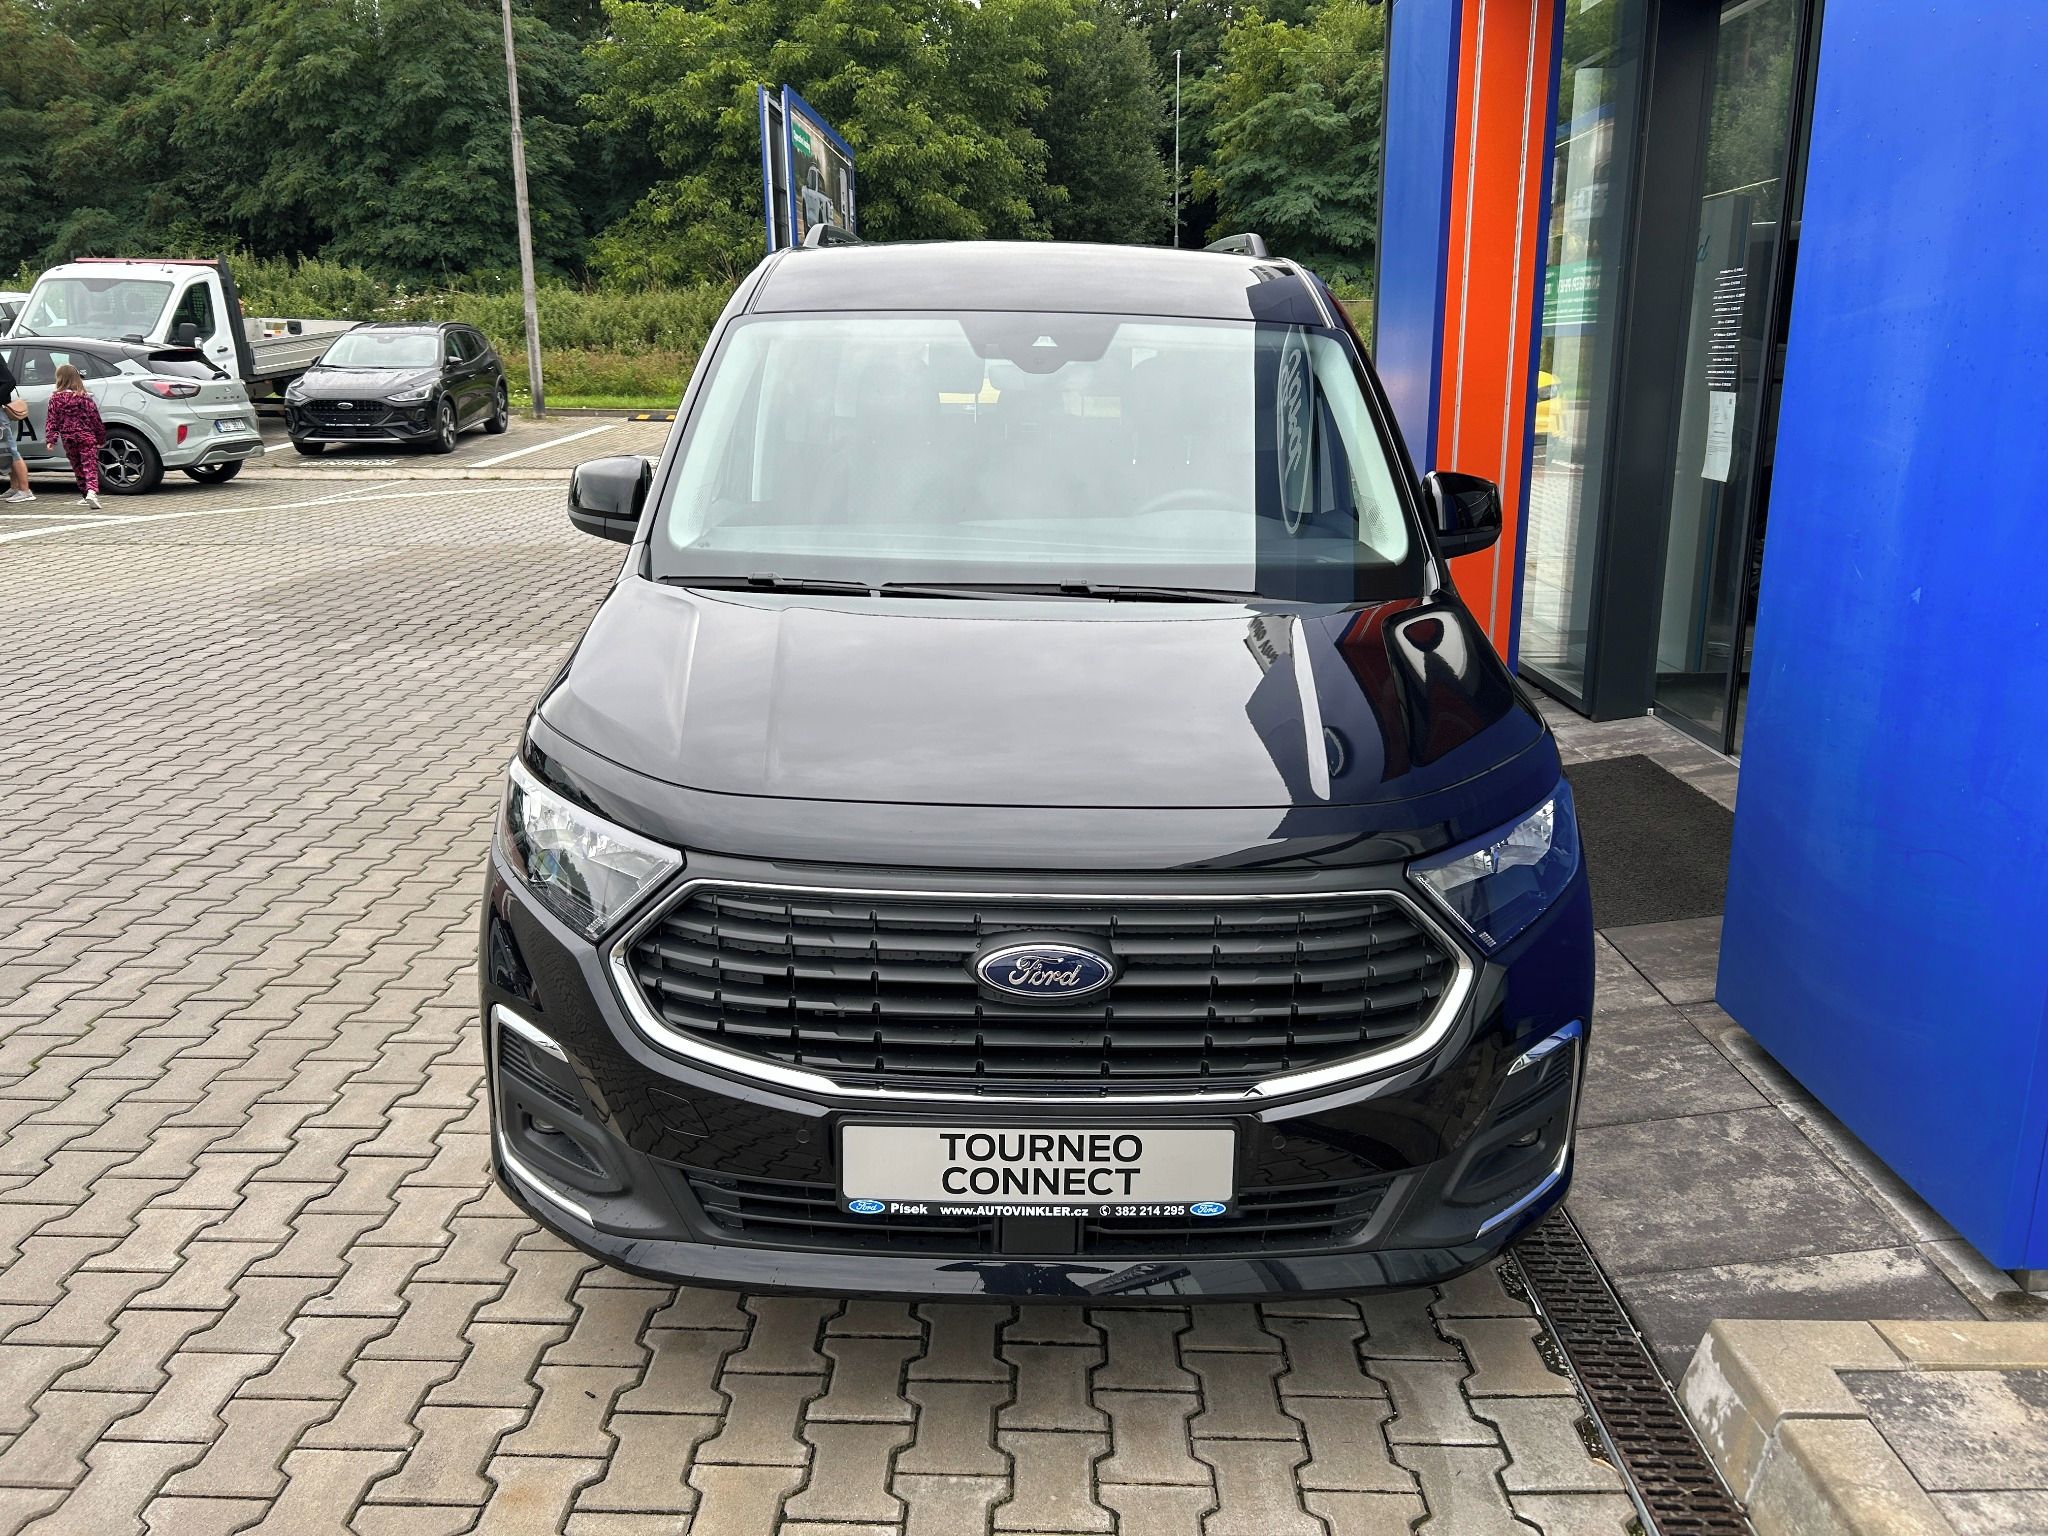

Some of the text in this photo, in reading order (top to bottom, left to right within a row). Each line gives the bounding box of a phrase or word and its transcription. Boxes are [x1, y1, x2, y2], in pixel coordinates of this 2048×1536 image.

[1008, 955, 1082, 987] Ford
[940, 1133, 1143, 1162] TOURNEO
[942, 1166, 1141, 1195] CONNECT
[890, 1203, 928, 1214] Písek
[939, 1205, 1089, 1217] www.AUTOVINKLER.cz
[1115, 1205, 1137, 1216] 382
[1139, 1205, 1161, 1216] 214
[1163, 1205, 1185, 1216] 295
